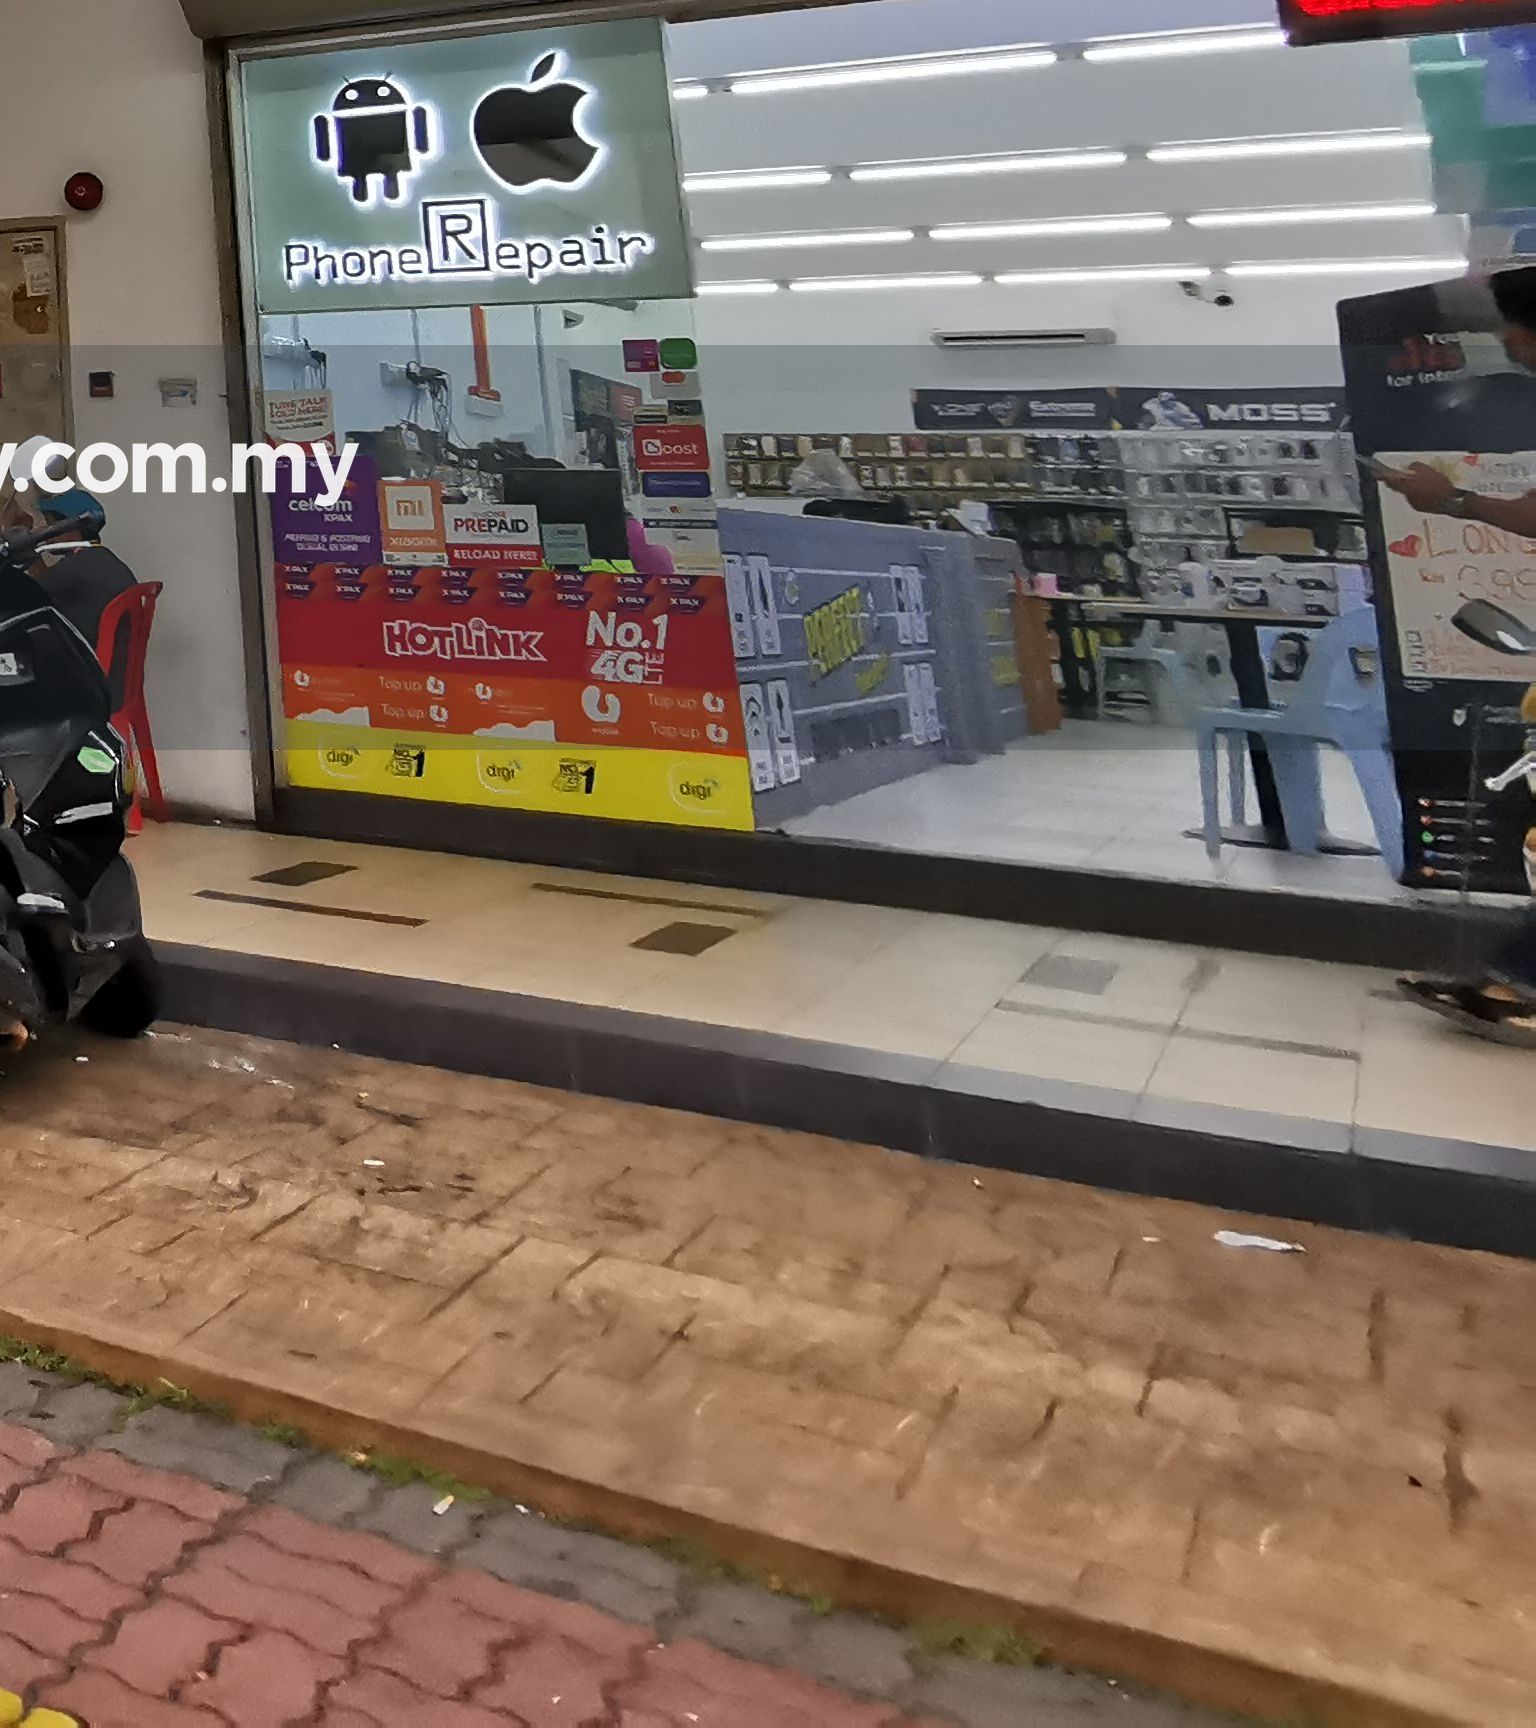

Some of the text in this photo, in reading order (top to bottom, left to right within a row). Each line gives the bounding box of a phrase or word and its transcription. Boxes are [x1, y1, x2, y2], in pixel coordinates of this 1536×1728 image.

[1205, 403, 1331, 422] MOSS
[453, 517, 529, 535] PREPAID
[585, 609, 669, 650] No.1
[590, 650, 645, 683] 4G
